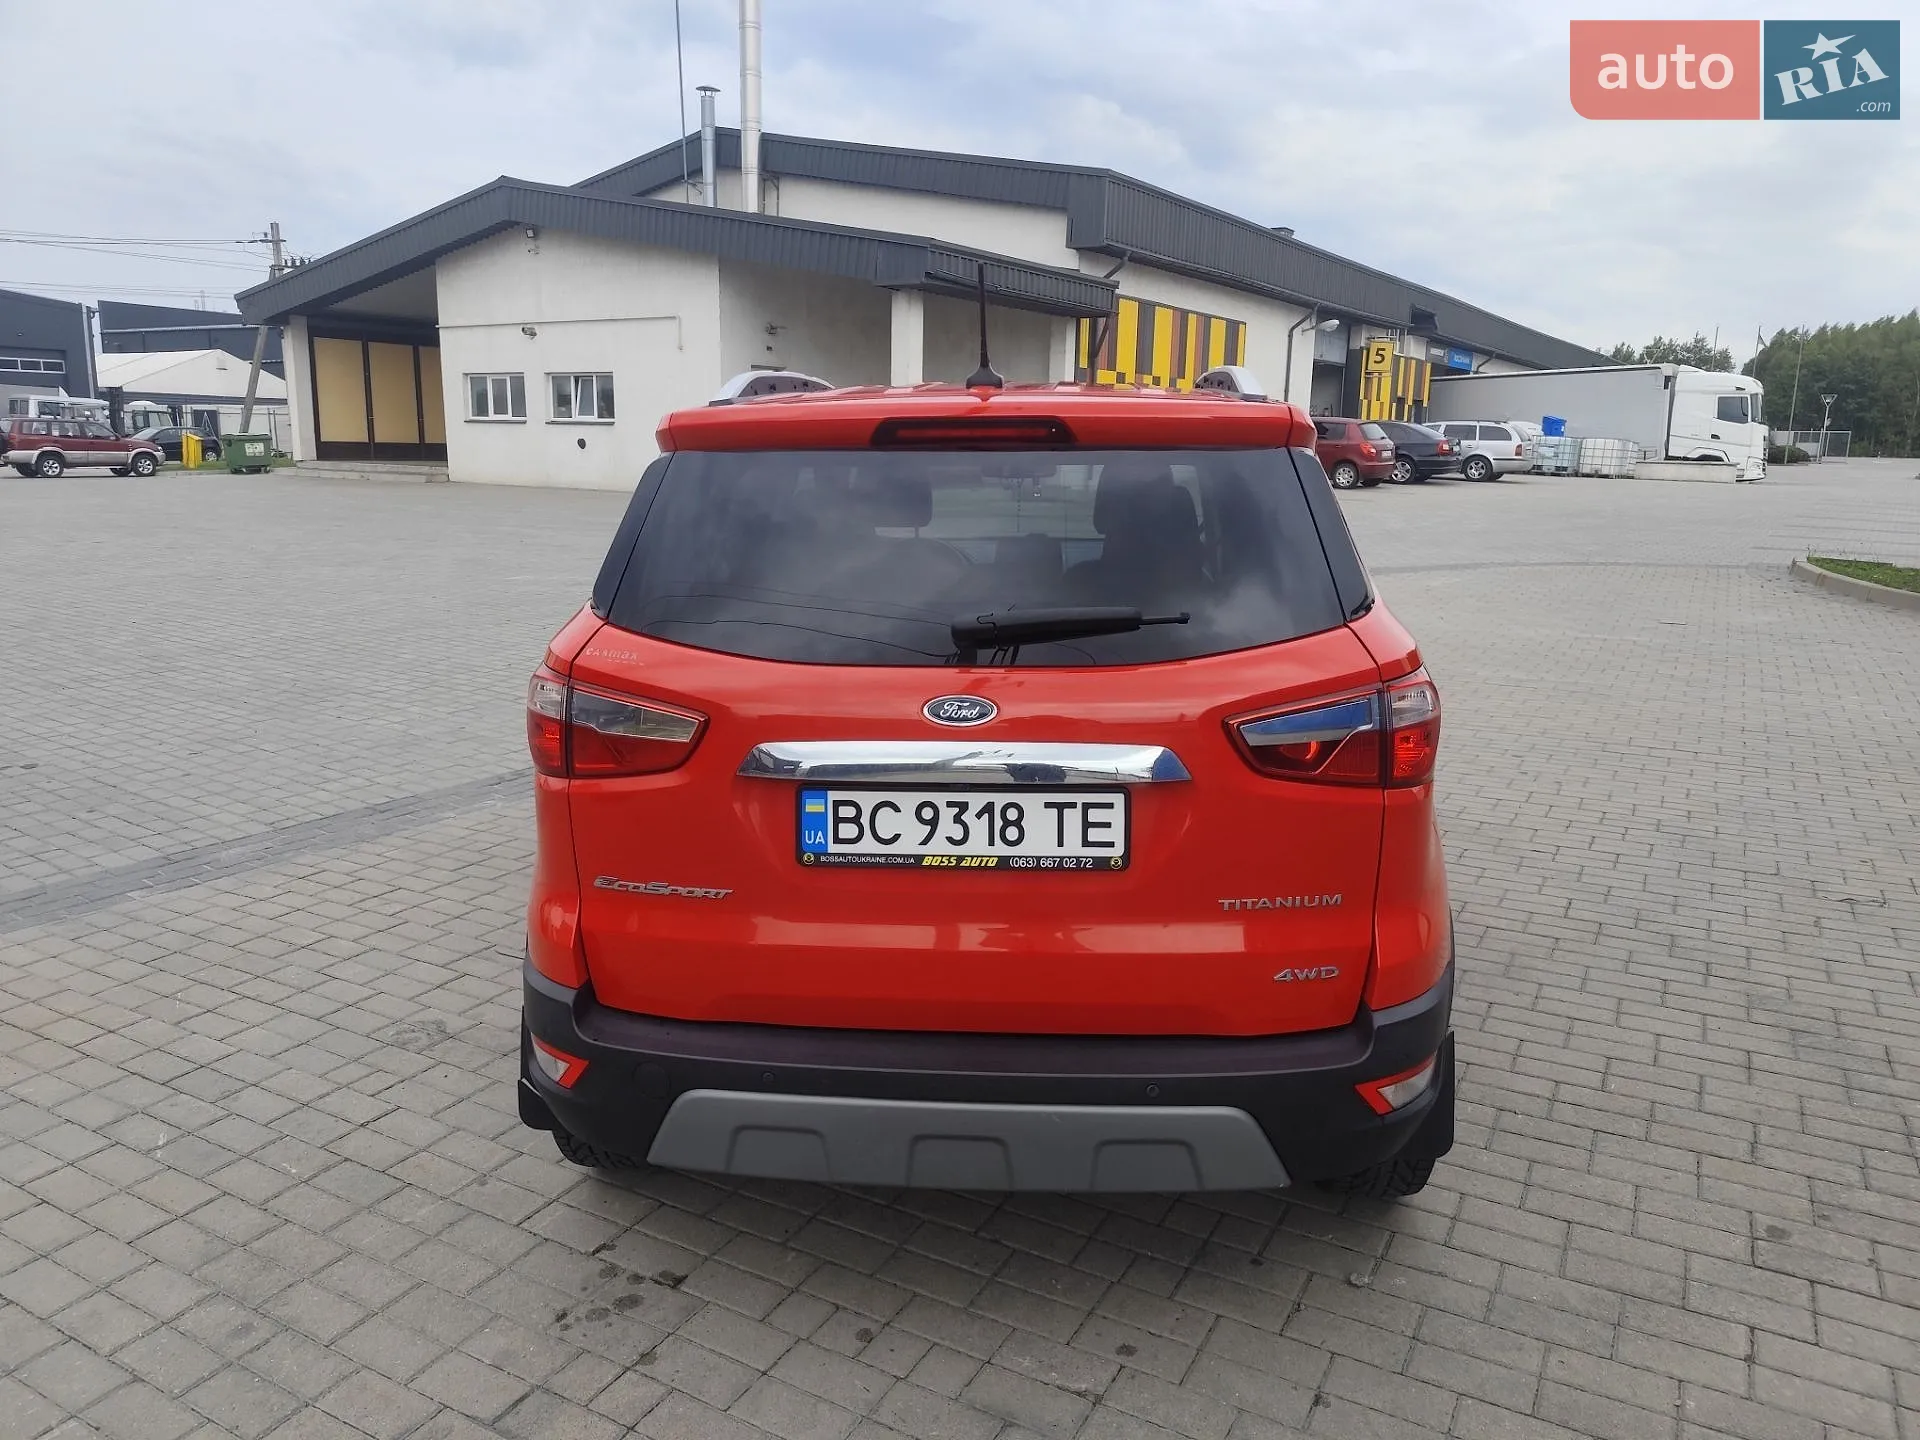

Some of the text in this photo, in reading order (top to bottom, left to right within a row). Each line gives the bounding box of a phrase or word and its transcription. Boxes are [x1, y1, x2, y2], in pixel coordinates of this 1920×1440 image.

[1373, 347, 1387, 364] 5
[940, 701, 980, 719] Ford
[832, 799, 1116, 848] BC 9318 TE
[805, 830, 825, 844] UA
[820, 855, 915, 864] BOSSAUTOUKRAINE.COM.UA
[920, 856, 999, 867] BOSS AUTO
[1009, 856, 1093, 868] (063) 667 02 72
[1218, 893, 1343, 911] TITANIUM
[1273, 966, 1340, 982] 4WD
